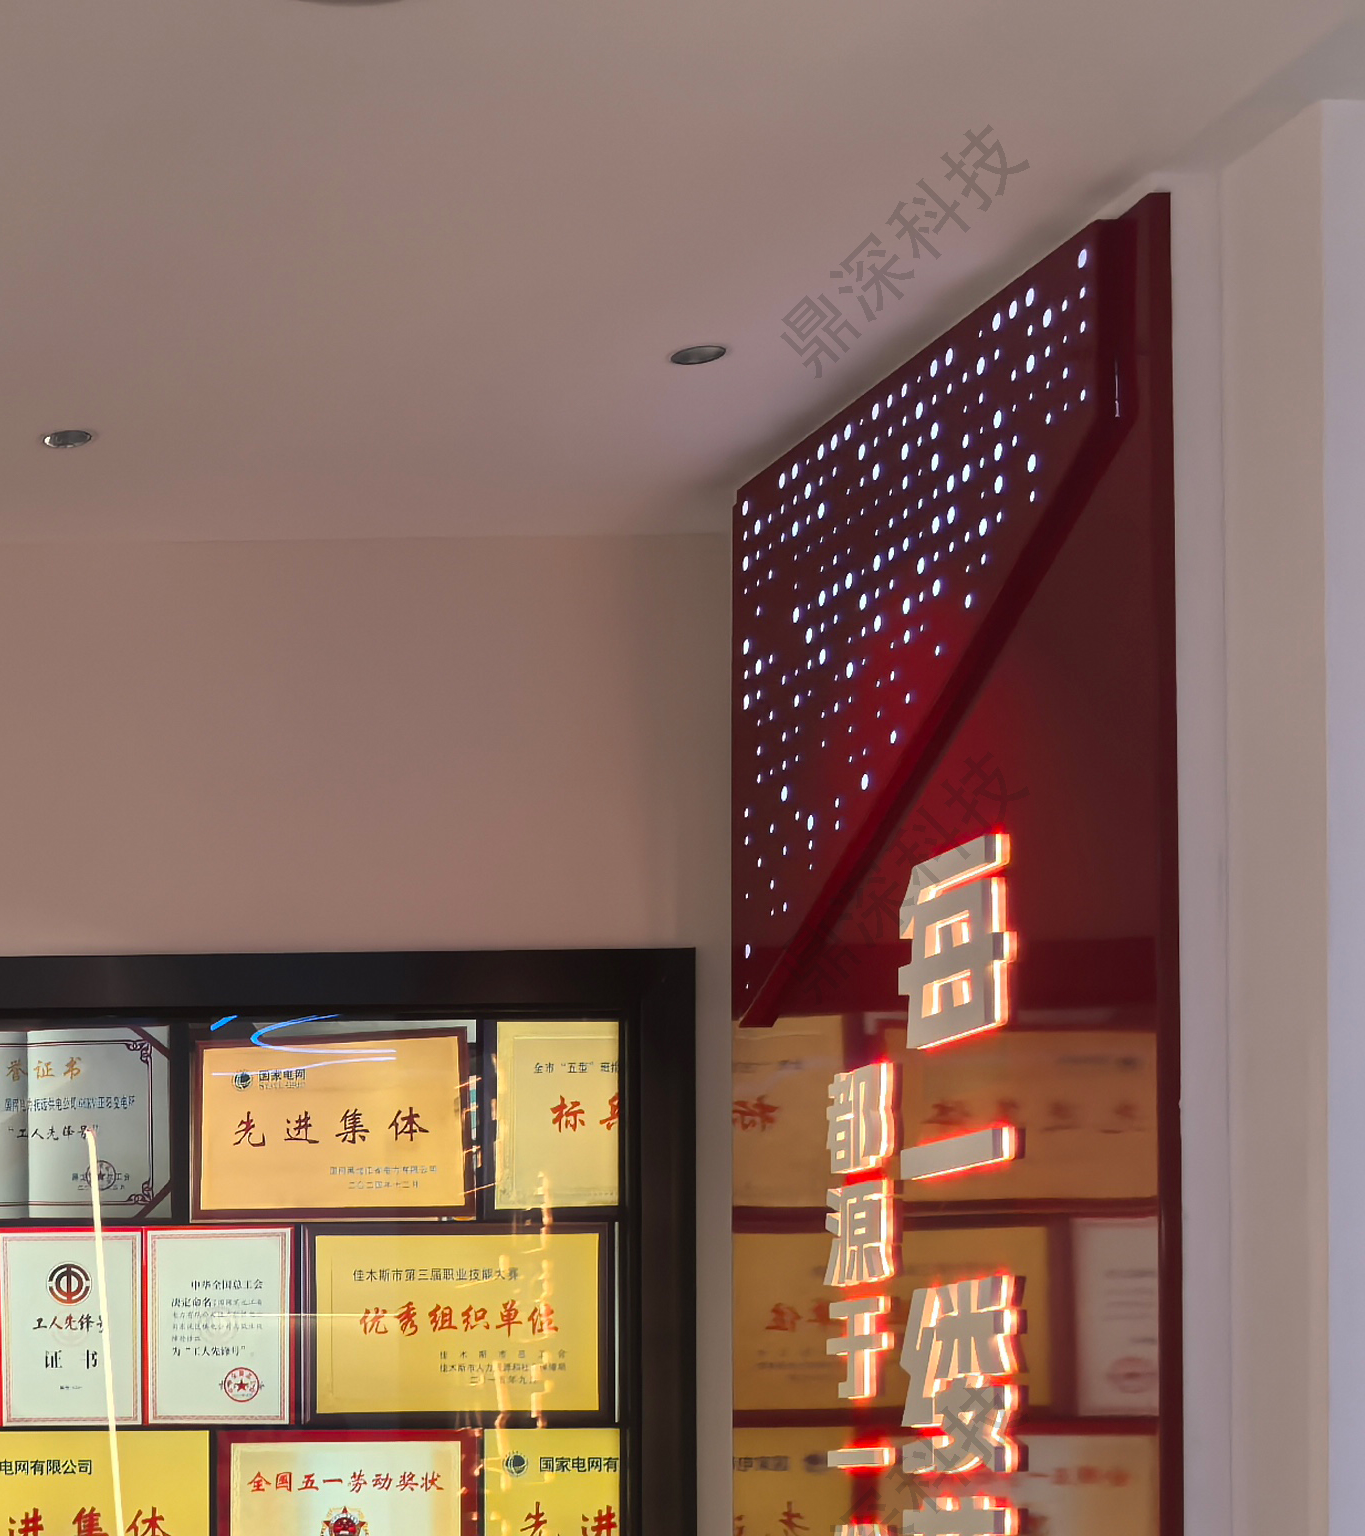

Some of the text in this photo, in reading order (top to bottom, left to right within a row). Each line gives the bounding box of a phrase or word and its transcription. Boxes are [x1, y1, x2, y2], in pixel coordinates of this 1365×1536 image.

[258, 1068, 307, 1082] 国家电网
[232, 1107, 430, 1147] 先进集体
[359, 1299, 559, 1337] 优秀组织单位
[45, 1350, 98, 1370] 证书
[246, 1469, 445, 1493] 全国五一劳动奖状
